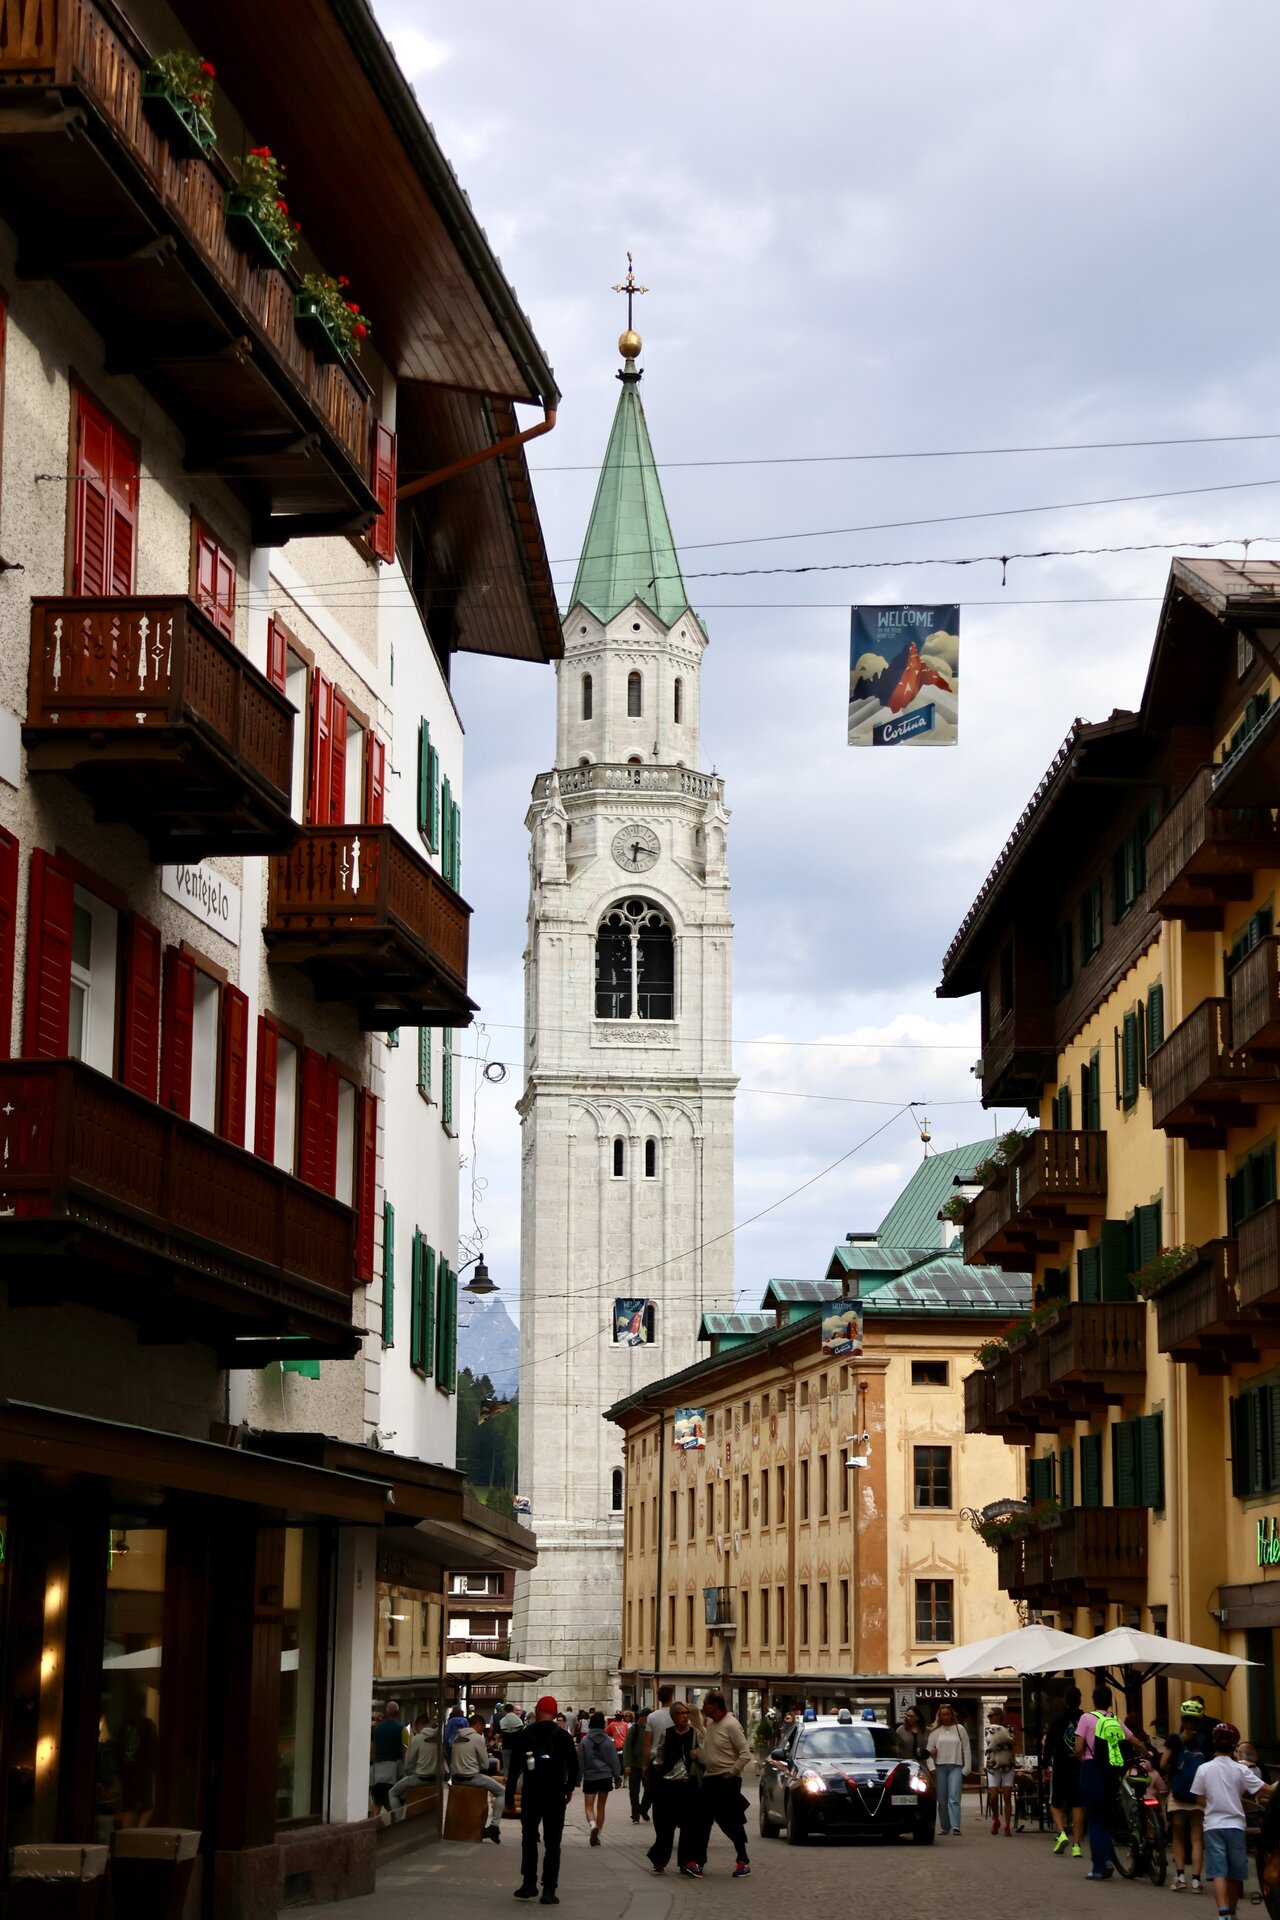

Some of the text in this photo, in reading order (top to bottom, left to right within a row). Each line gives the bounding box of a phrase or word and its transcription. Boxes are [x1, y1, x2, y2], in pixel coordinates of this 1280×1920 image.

[878, 610, 935, 627] WELCOME
[882, 715, 928, 742] Cortina
[915, 1689, 958, 1698] GUESS
